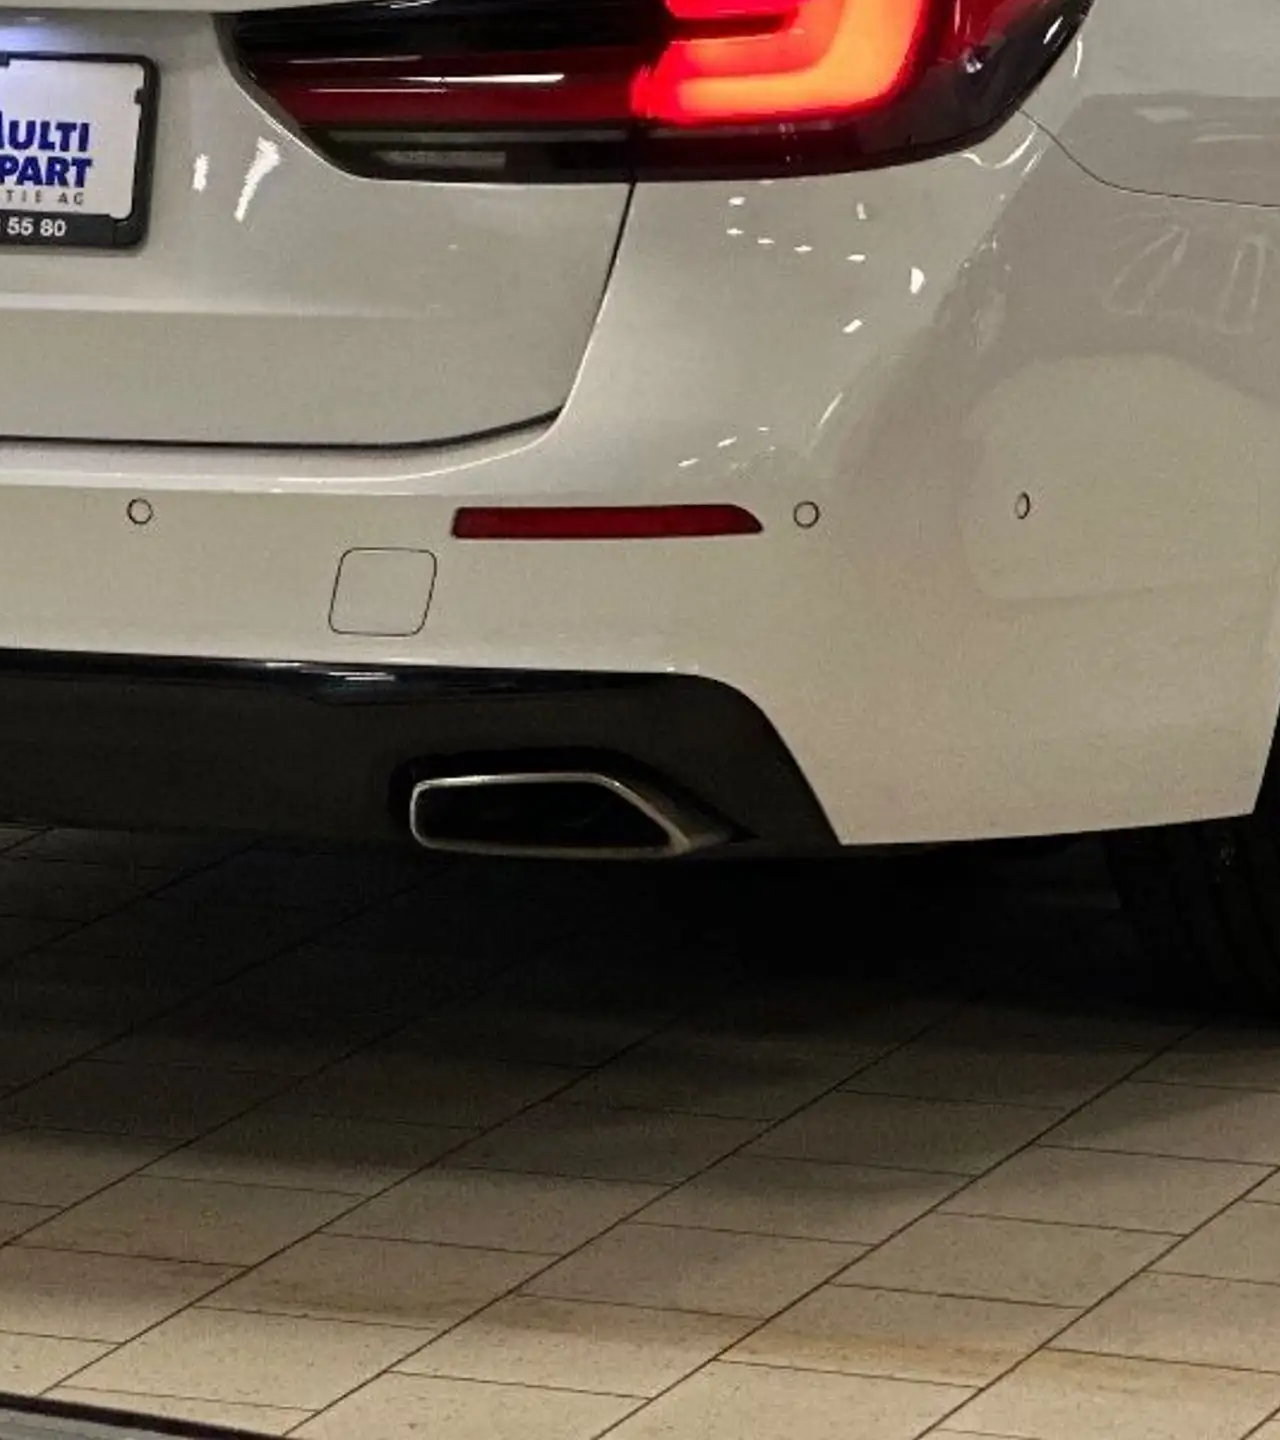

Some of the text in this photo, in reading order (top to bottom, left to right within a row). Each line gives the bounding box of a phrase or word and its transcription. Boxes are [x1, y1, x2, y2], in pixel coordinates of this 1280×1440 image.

[57, 190, 85, 205] AG
[7, 218, 34, 236] 55
[39, 219, 67, 237] 80
